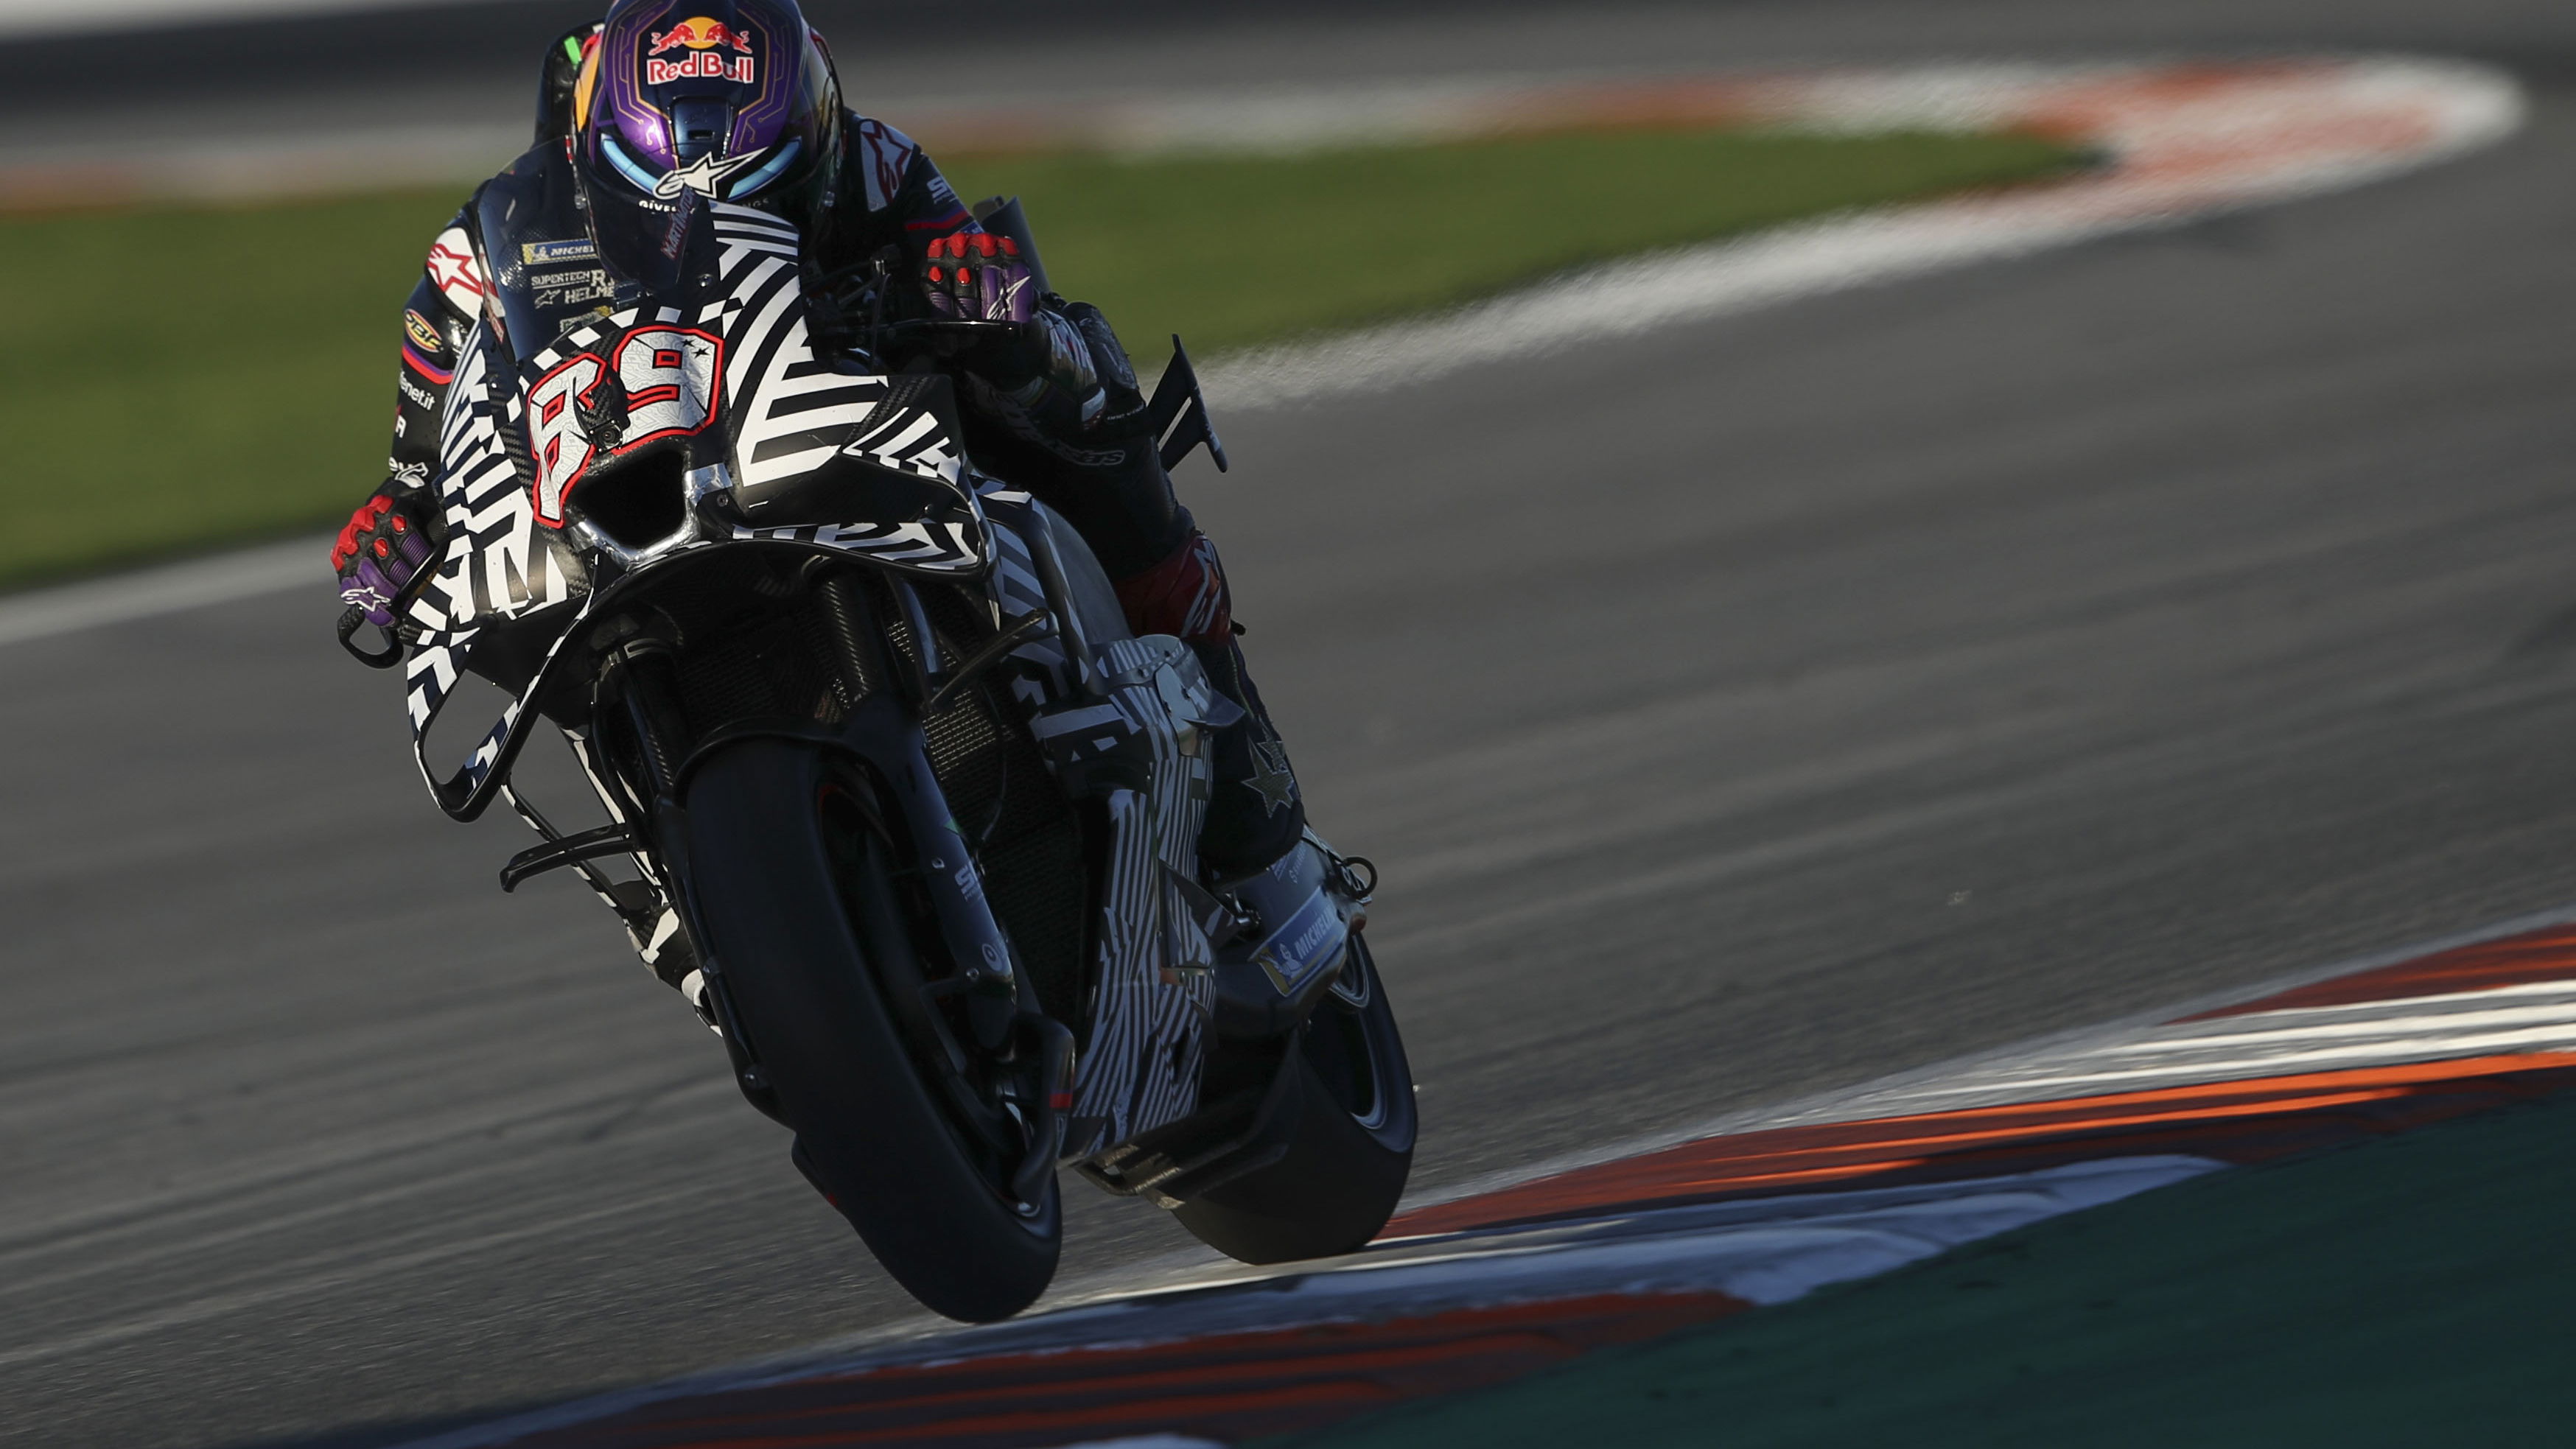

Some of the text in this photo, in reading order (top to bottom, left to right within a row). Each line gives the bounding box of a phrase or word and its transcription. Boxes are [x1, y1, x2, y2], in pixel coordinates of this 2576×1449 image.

[647, 51, 755, 85] Red Bull
[531, 271, 589, 287] SUPERTECH
[564, 287, 614, 304] HELME
[528, 326, 724, 529] 89
